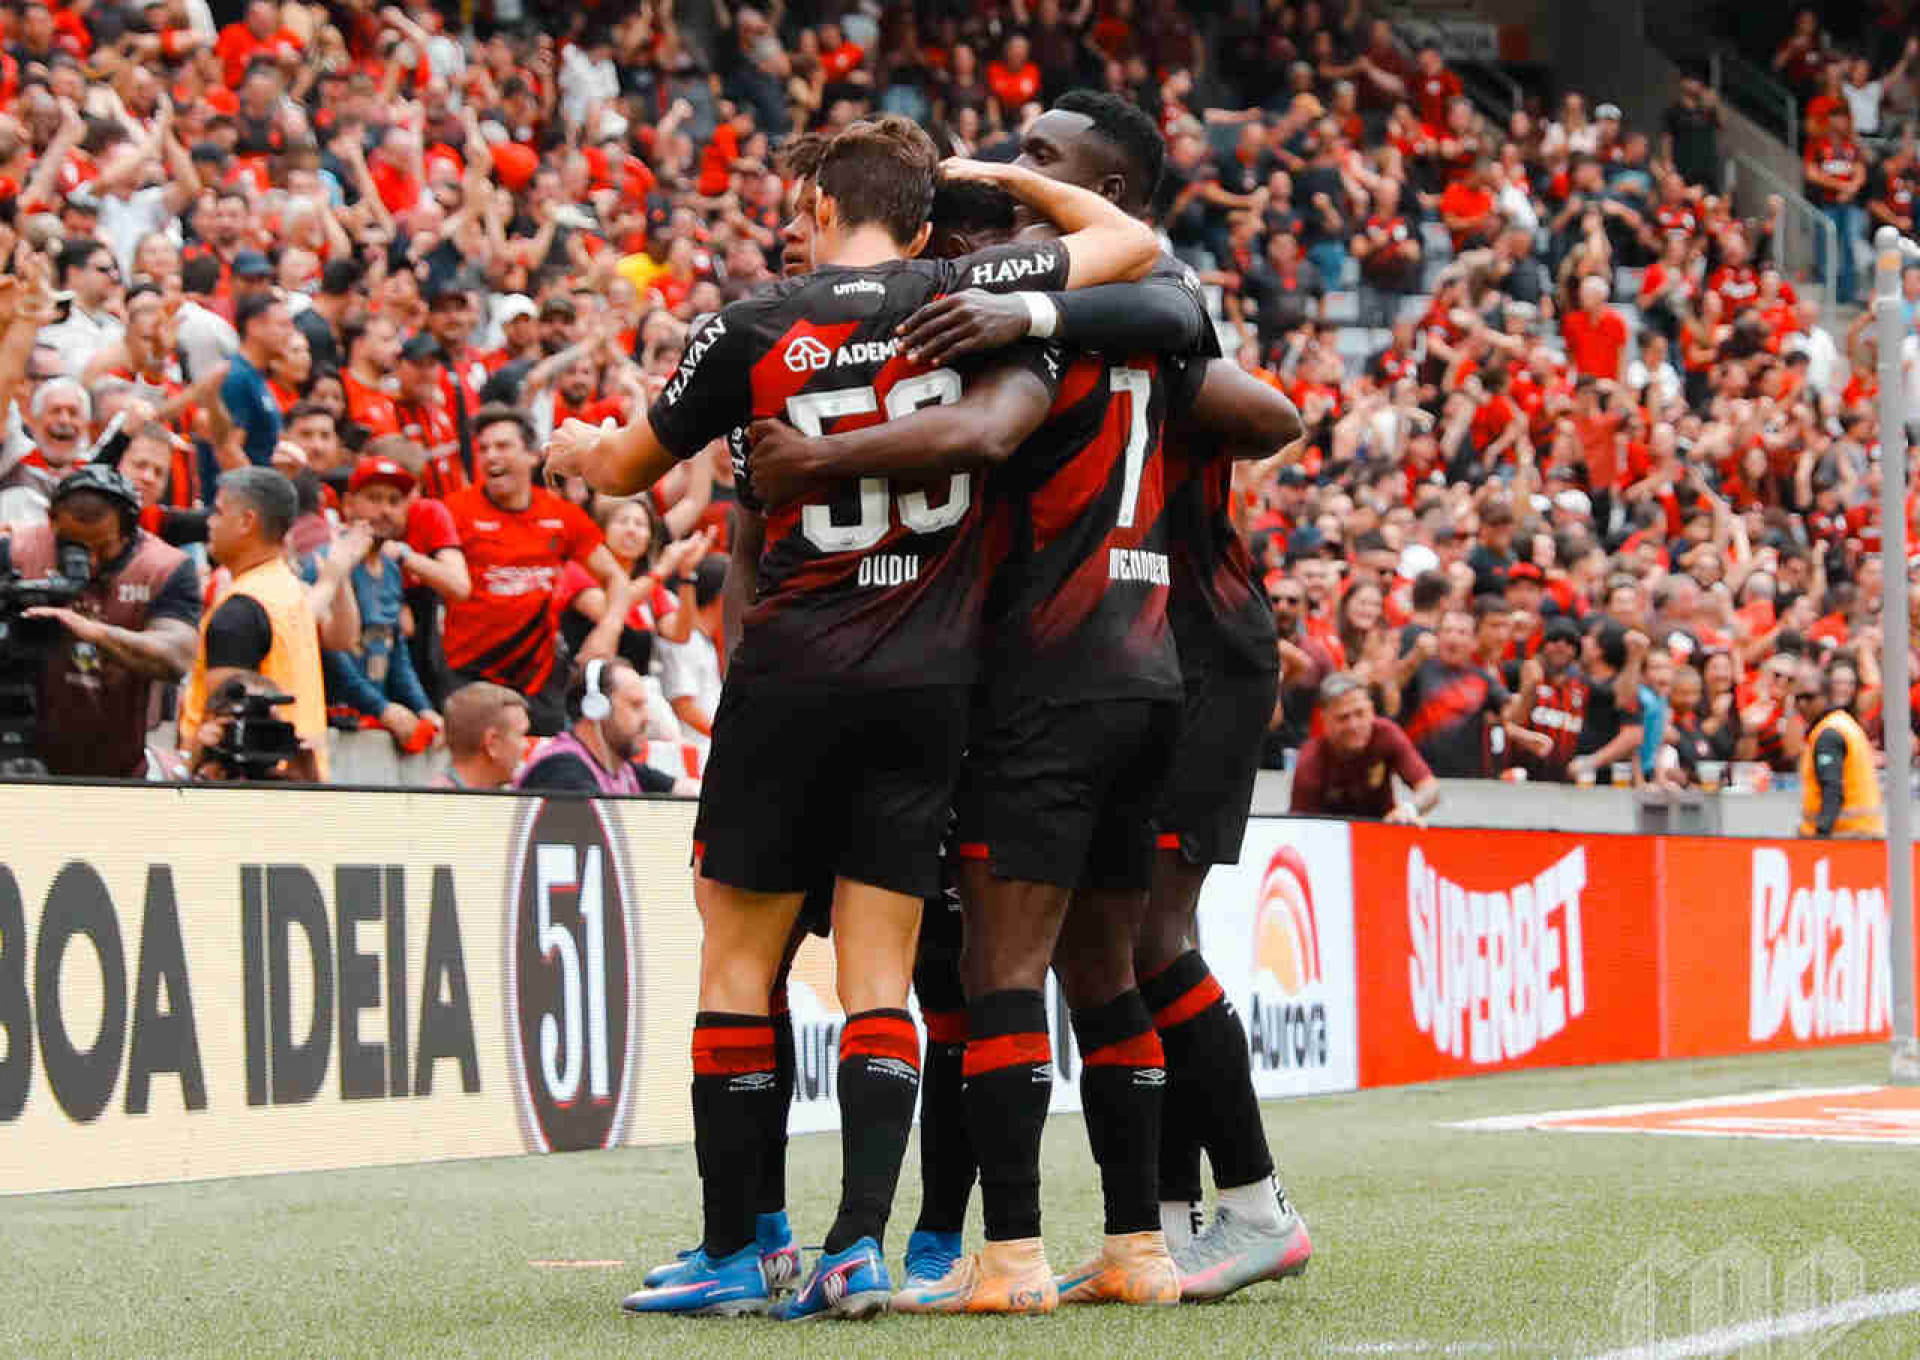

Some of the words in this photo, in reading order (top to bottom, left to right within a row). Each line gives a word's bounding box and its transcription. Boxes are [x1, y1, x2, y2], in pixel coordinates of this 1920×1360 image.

[971, 252, 1056, 286] HAVAN
[665, 315, 728, 406] HAVAN
[836, 337, 900, 368] ADEM
[1109, 365, 1152, 528] 7
[858, 554, 919, 586] DUDU
[240, 863, 481, 1107] IDEIA
[536, 844, 611, 1103] 51
[1407, 846, 1587, 1064] SUPERBET
[1749, 848, 1893, 1042] Betan
[1250, 992, 1327, 1071] Aurora
